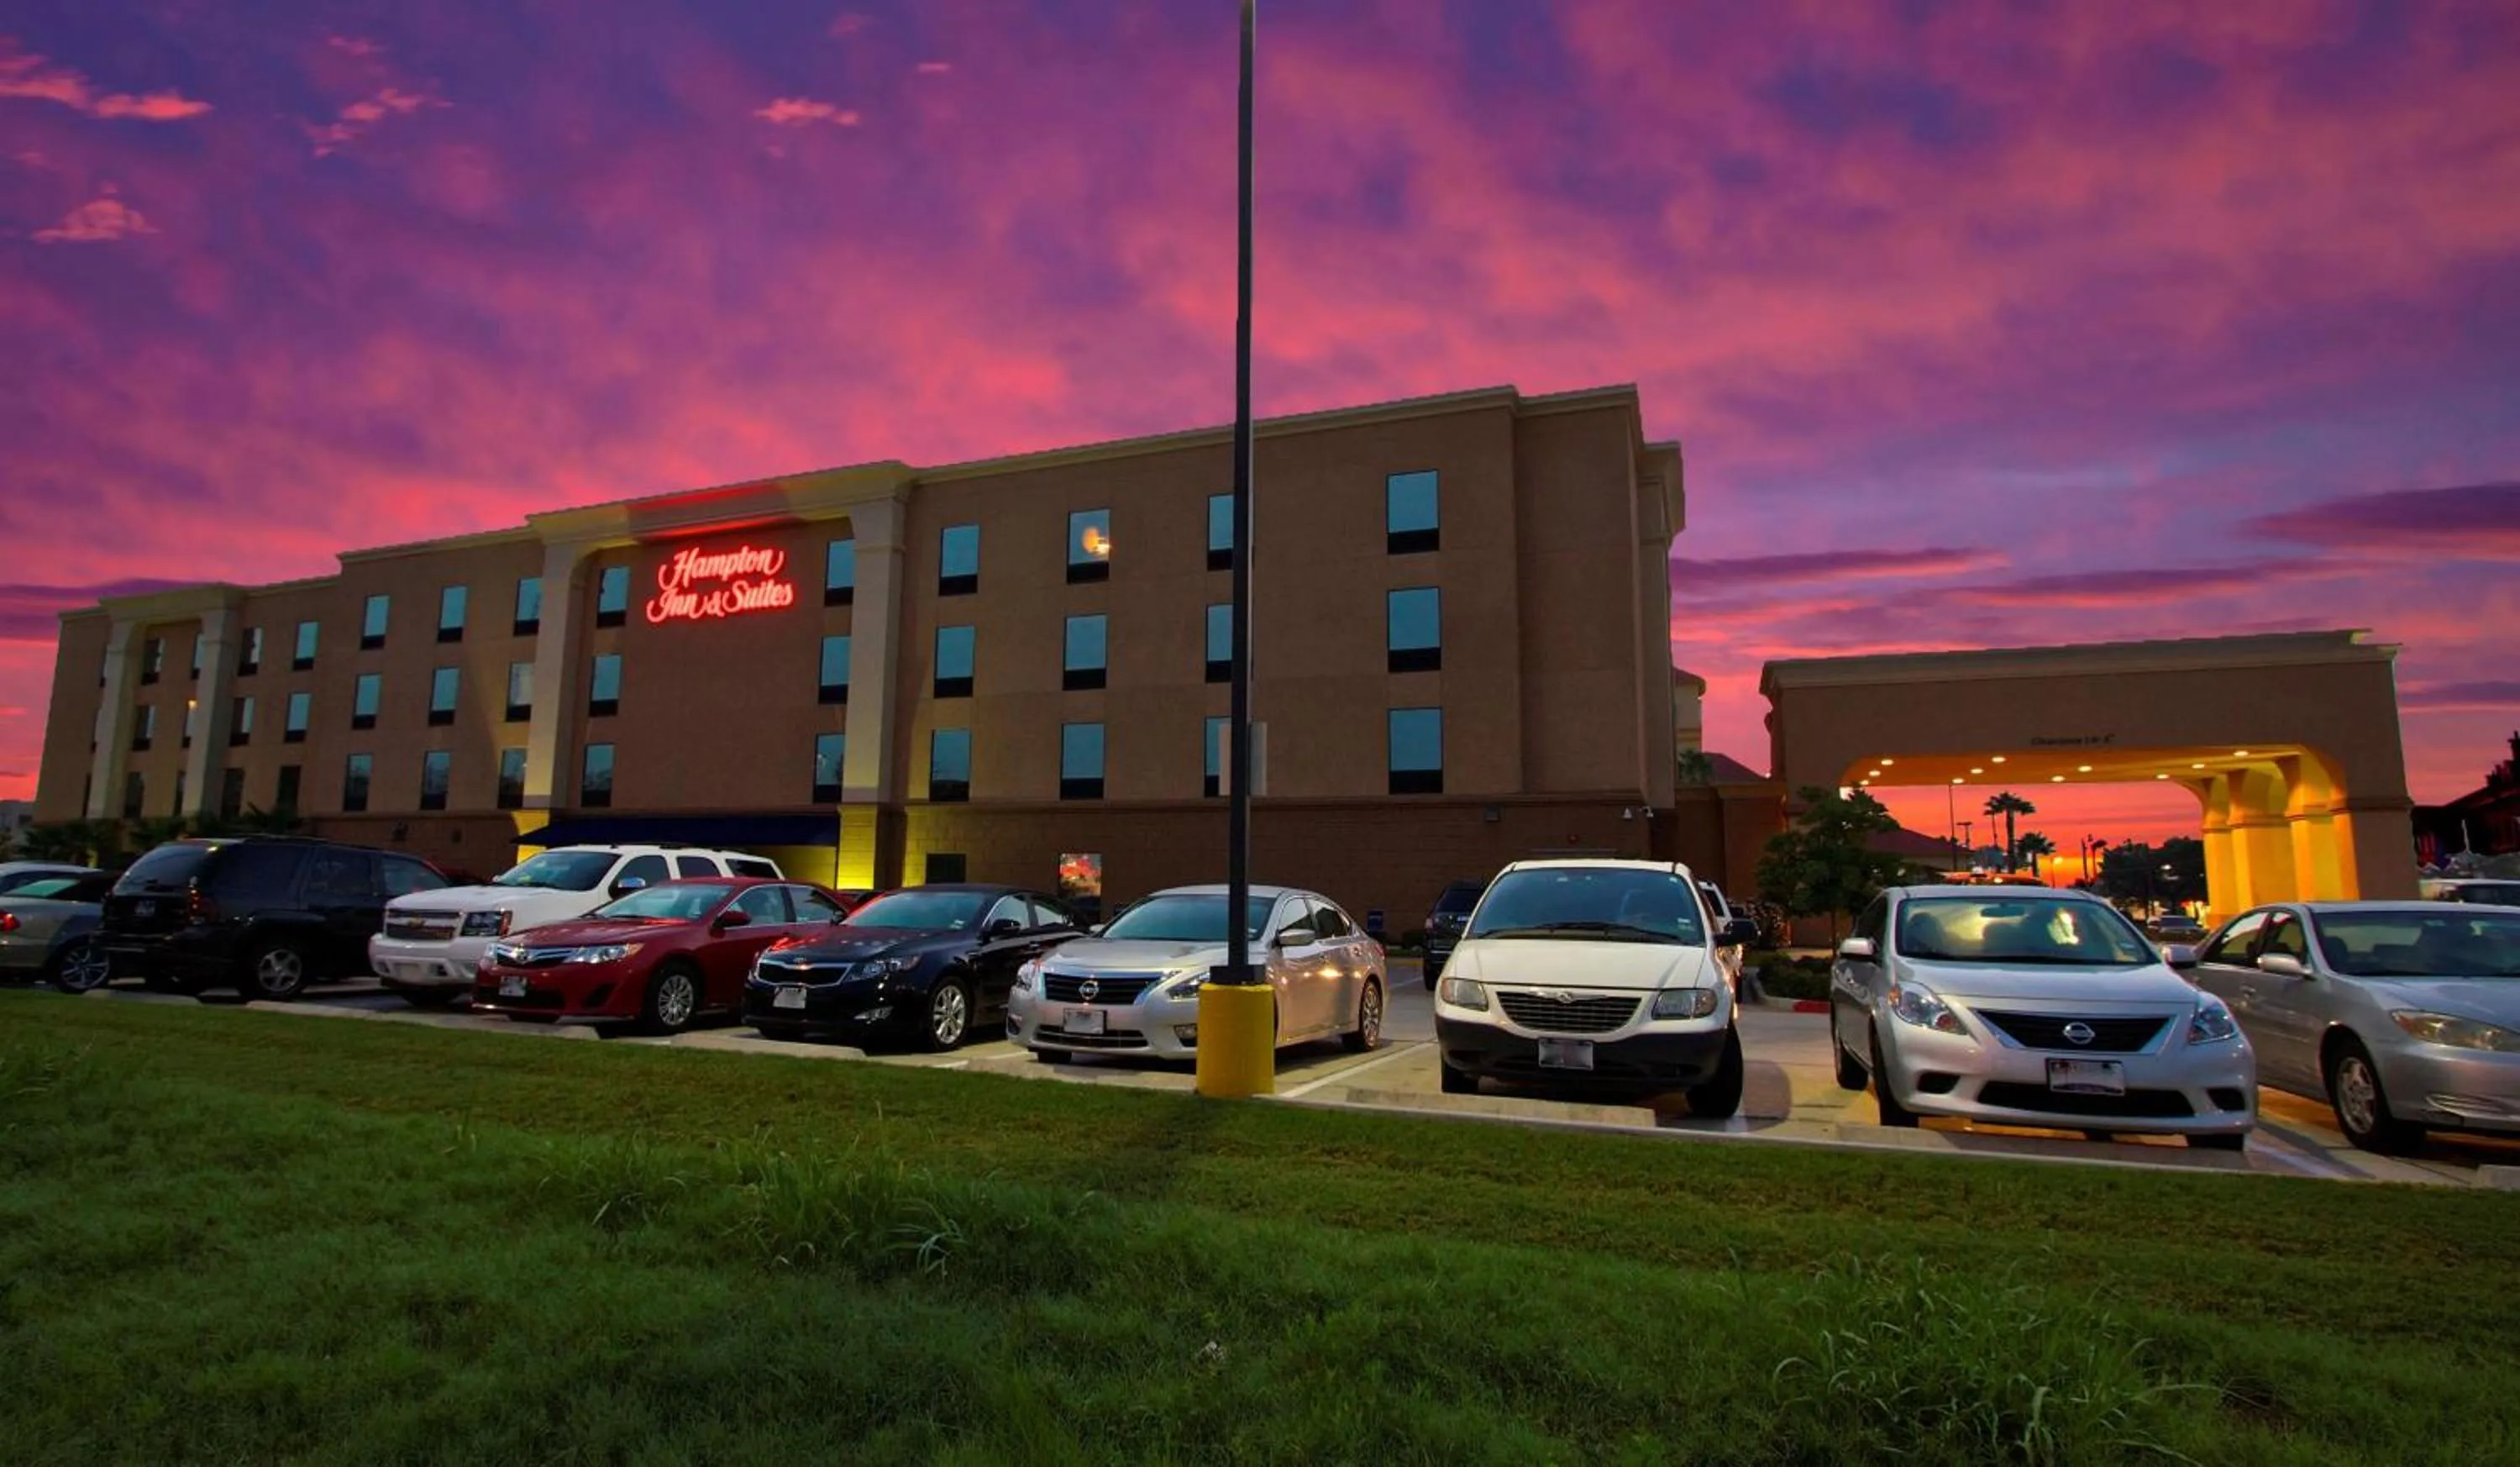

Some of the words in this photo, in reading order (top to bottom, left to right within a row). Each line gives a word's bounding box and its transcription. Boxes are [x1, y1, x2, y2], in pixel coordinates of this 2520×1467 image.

[658, 545, 785, 589] Hampton
[646, 587, 708, 623] Inn
[706, 591, 725, 617] &
[722, 579, 794, 613] Suites
